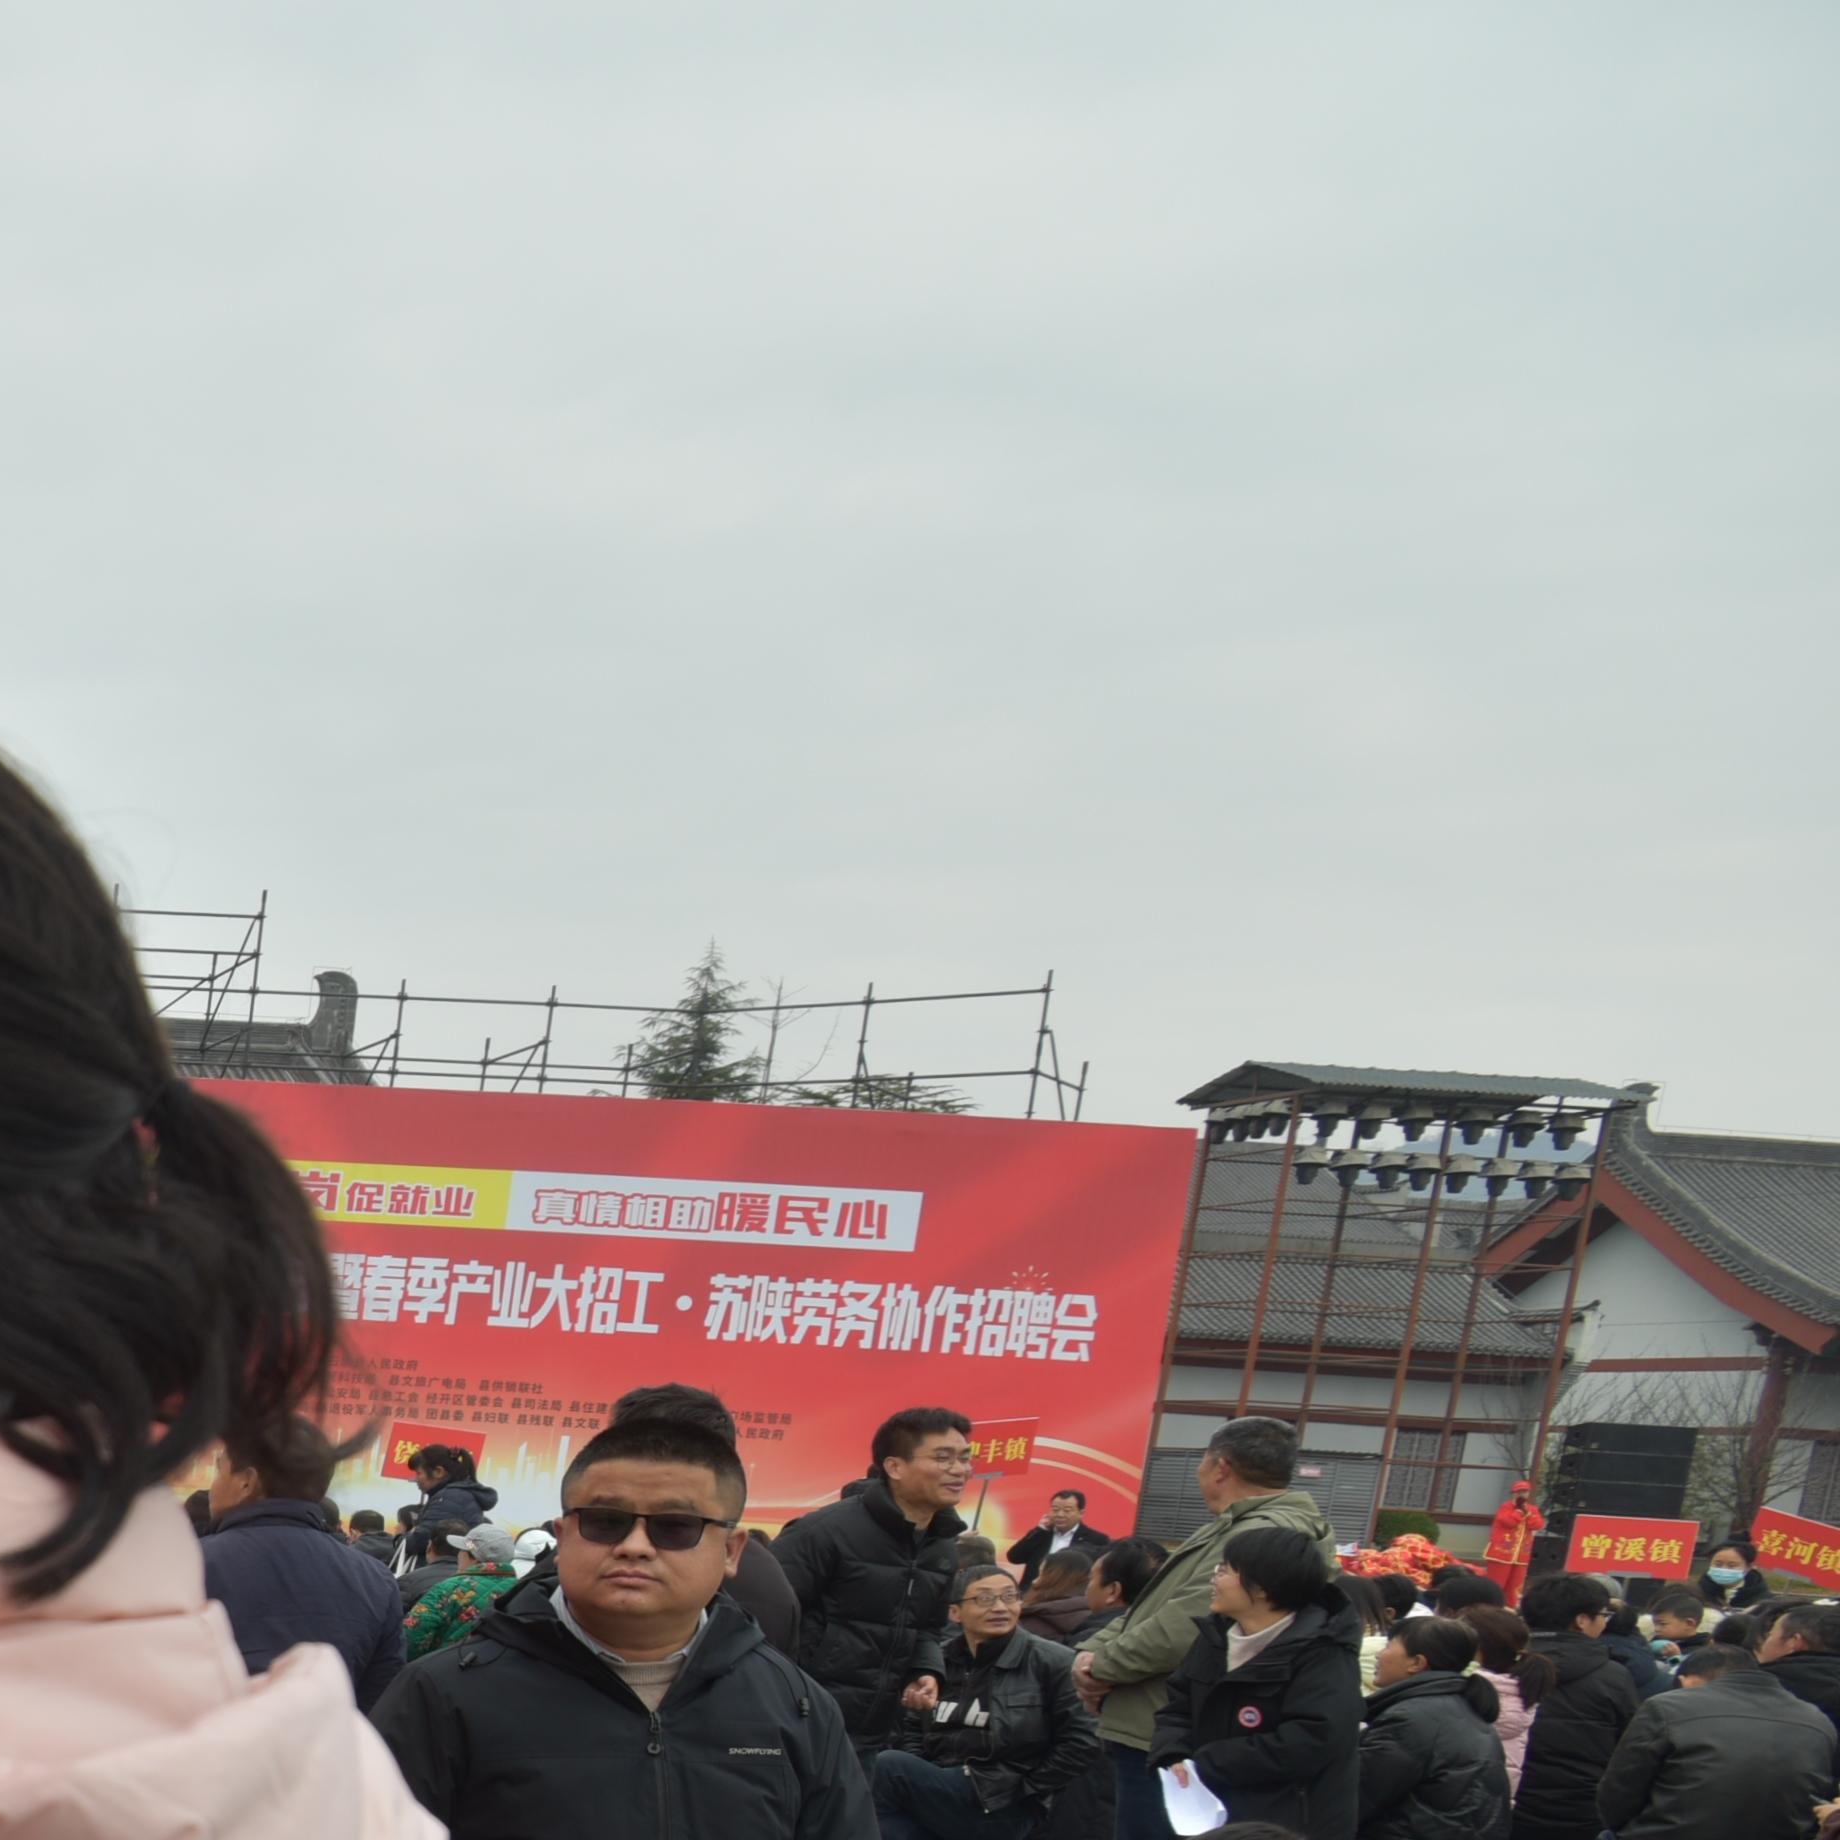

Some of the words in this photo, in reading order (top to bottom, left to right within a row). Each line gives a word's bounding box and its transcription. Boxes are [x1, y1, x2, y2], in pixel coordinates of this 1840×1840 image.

[532, 1187, 888, 1240] 真情相助暖民心
[1581, 1533, 1684, 1564] 曾溪镇
[1757, 1529, 1840, 1573] 喜河镇
